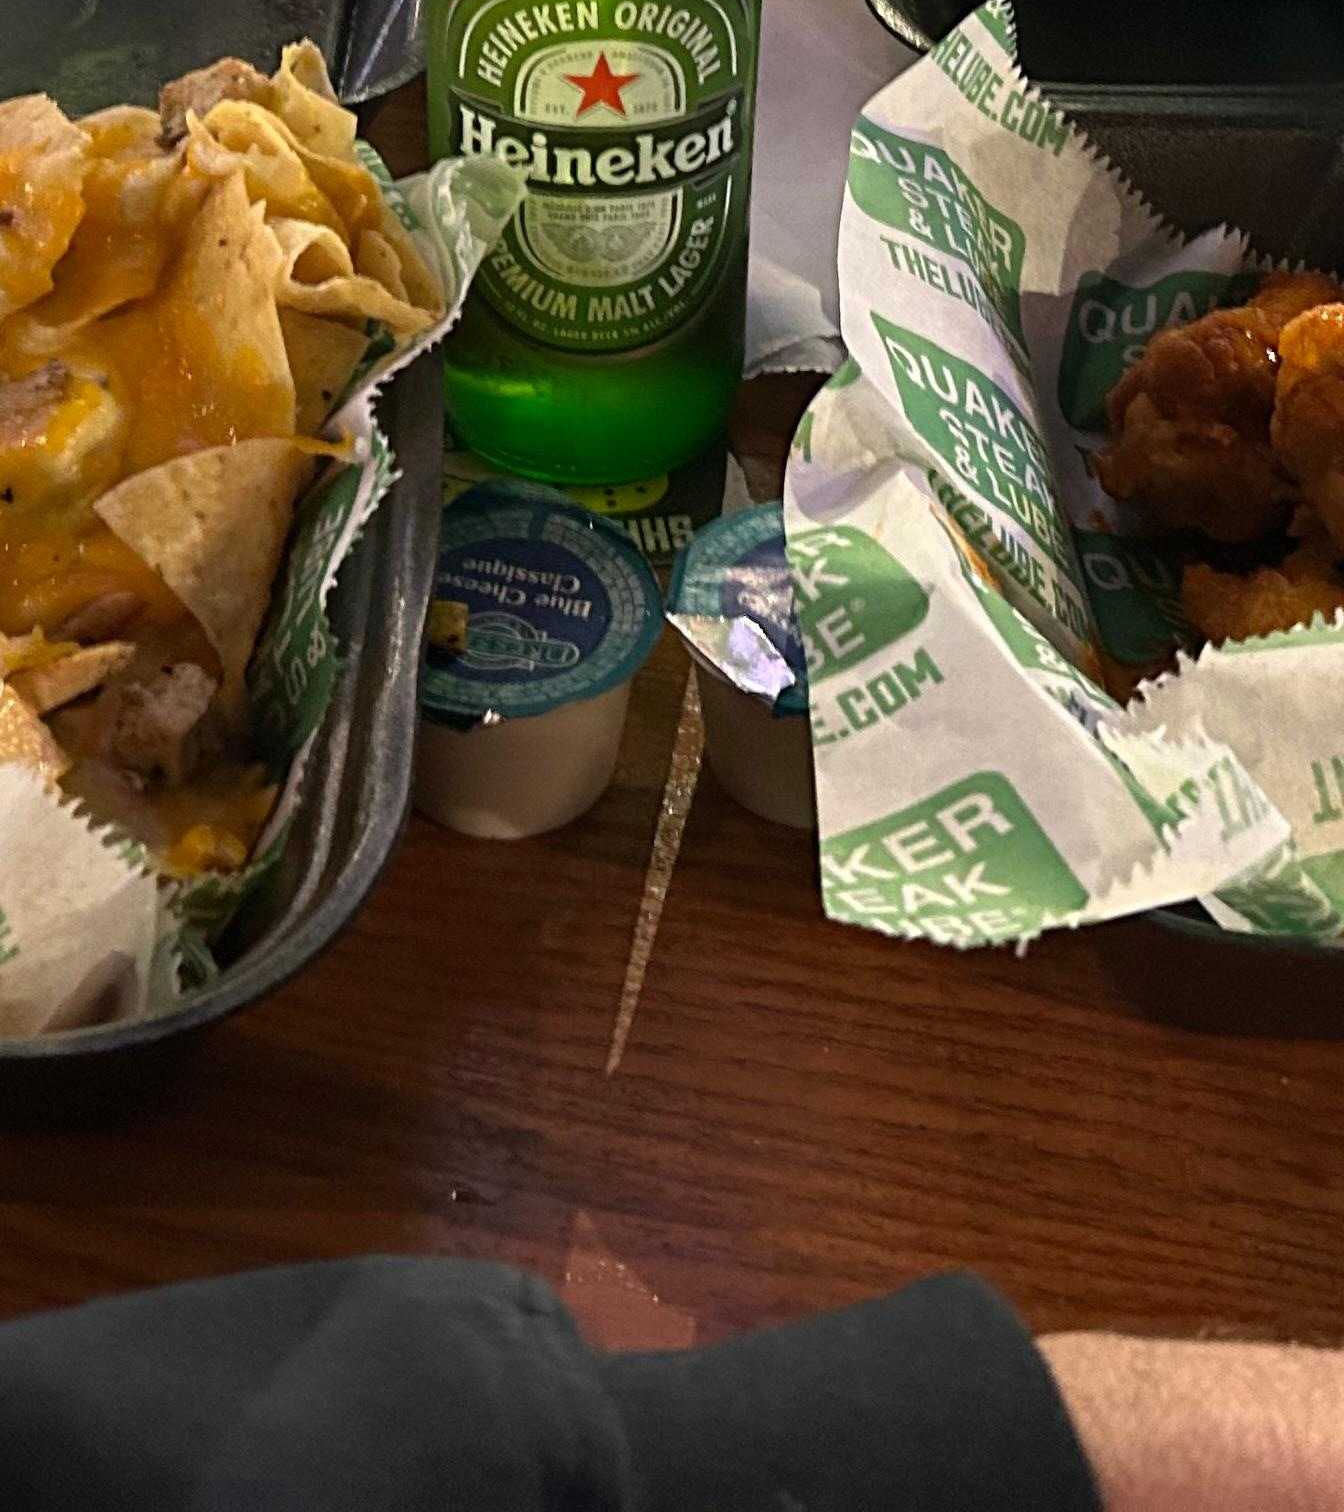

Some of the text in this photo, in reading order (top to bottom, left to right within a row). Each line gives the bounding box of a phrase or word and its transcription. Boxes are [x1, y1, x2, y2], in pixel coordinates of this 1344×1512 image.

[476, 0, 601, 88] HEINEKEN
[612, 0, 723, 86] ORIGINAL
[459, 104, 736, 187] Heineken
[587, 287, 656, 323] MALT
[664, 214, 715, 297] LAGER
[954, 445, 982, 487] &
[460, 557, 581, 595] Classique
[533, 592, 593, 622] Blue
